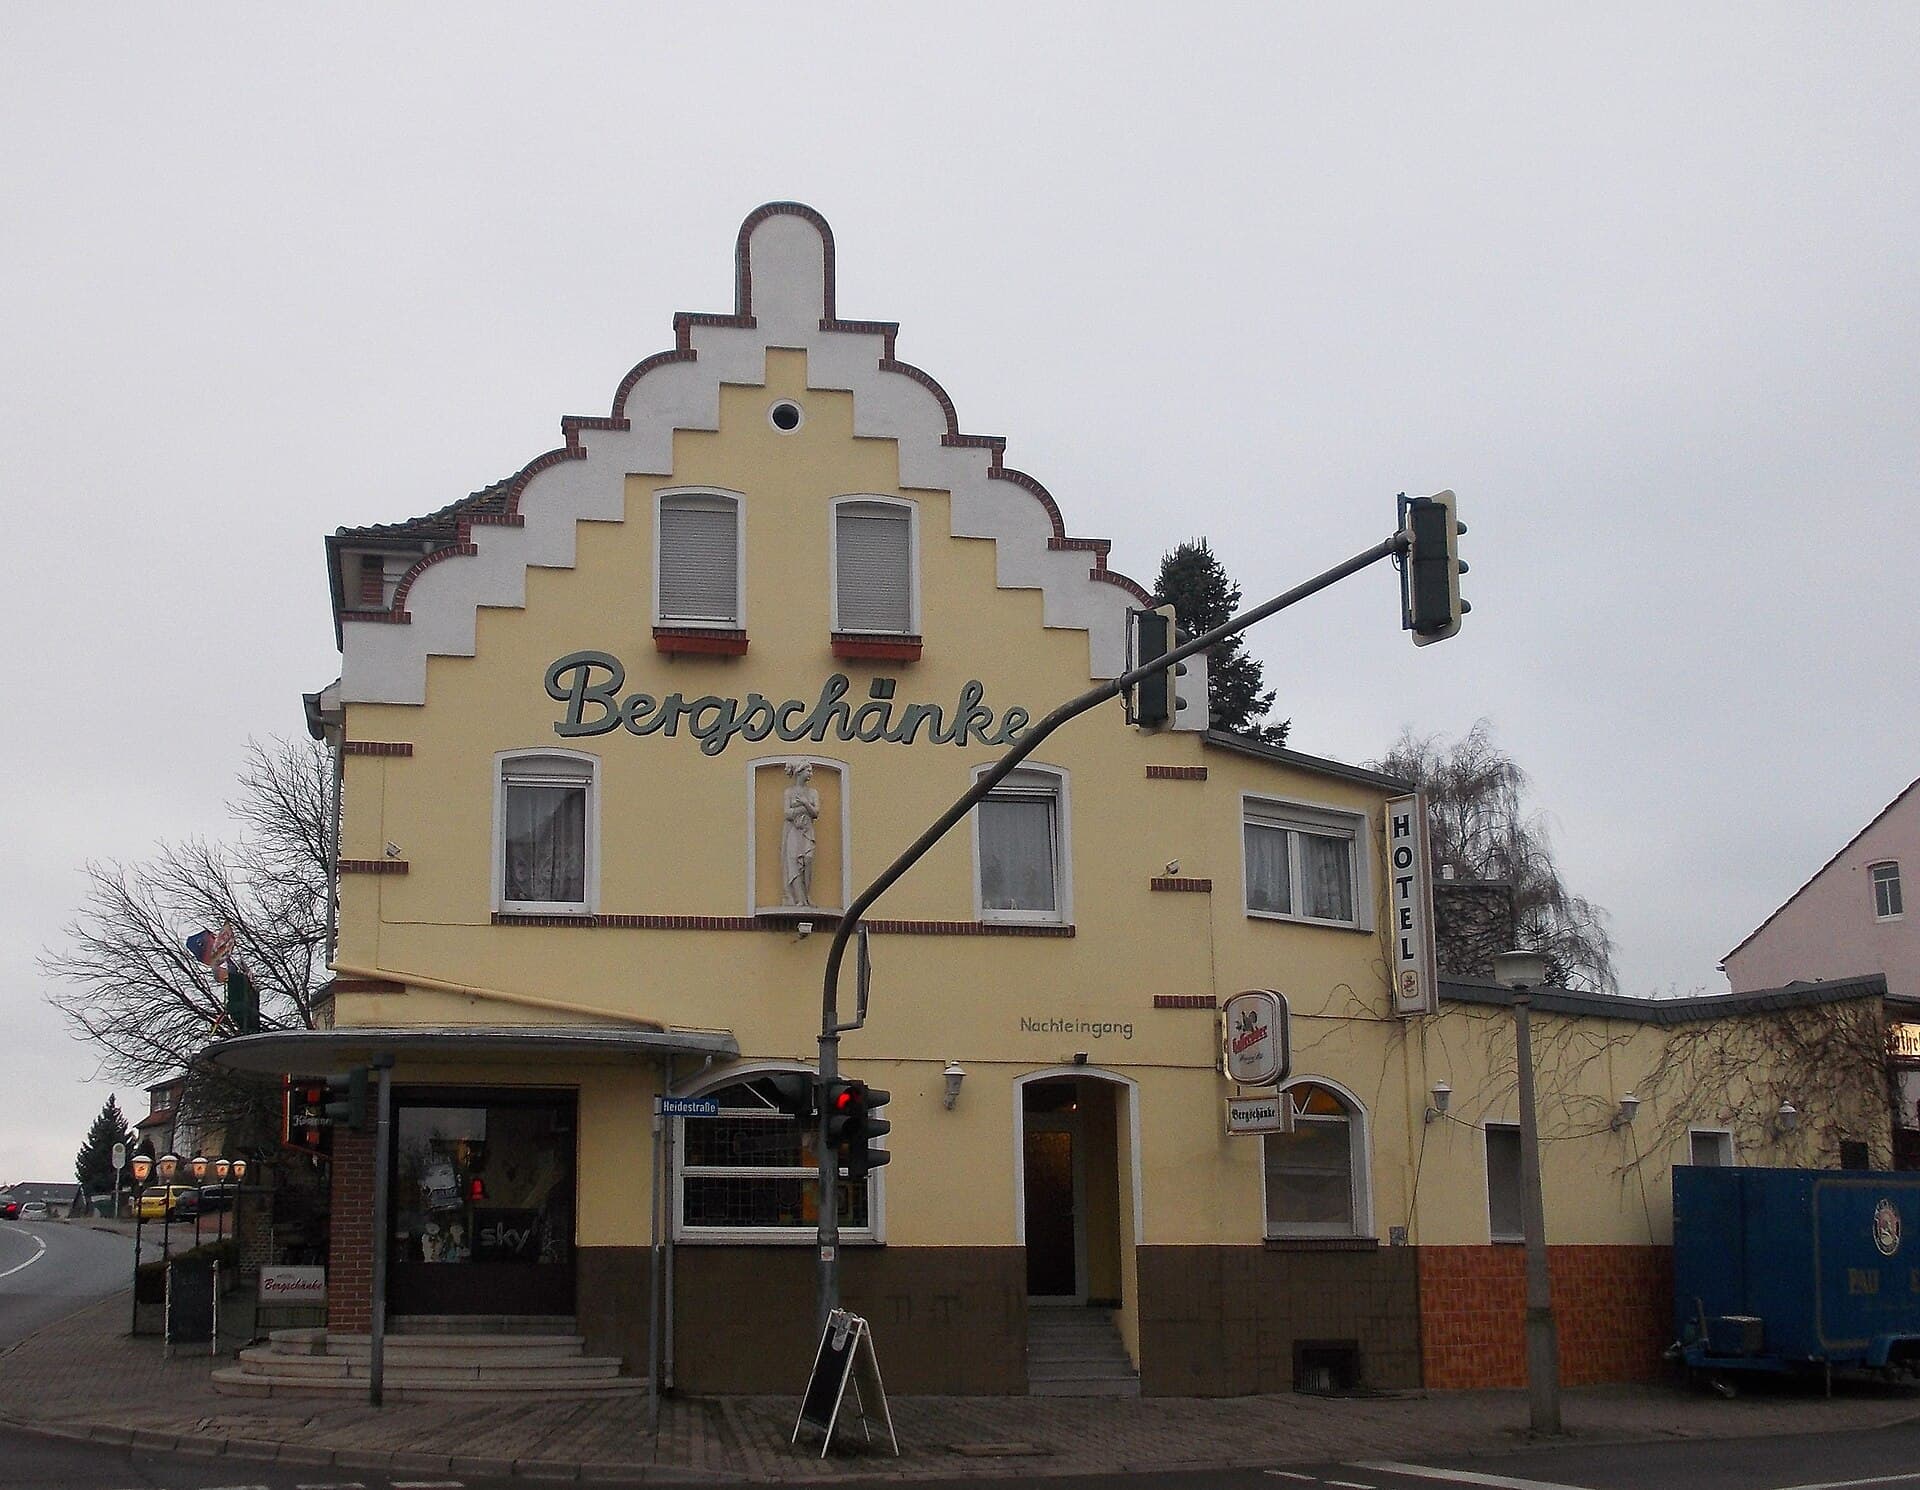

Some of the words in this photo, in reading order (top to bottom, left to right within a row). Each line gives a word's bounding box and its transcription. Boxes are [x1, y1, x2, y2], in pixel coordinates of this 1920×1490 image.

[544, 650, 1033, 756] Bergschänke
[1393, 814, 1415, 960] HOTEL
[1020, 1017, 1133, 1040] Nachteingang
[663, 1100, 716, 1113] Heidestraße
[1231, 1106, 1275, 1122] Bergschänke
[480, 1221, 530, 1253] sky
